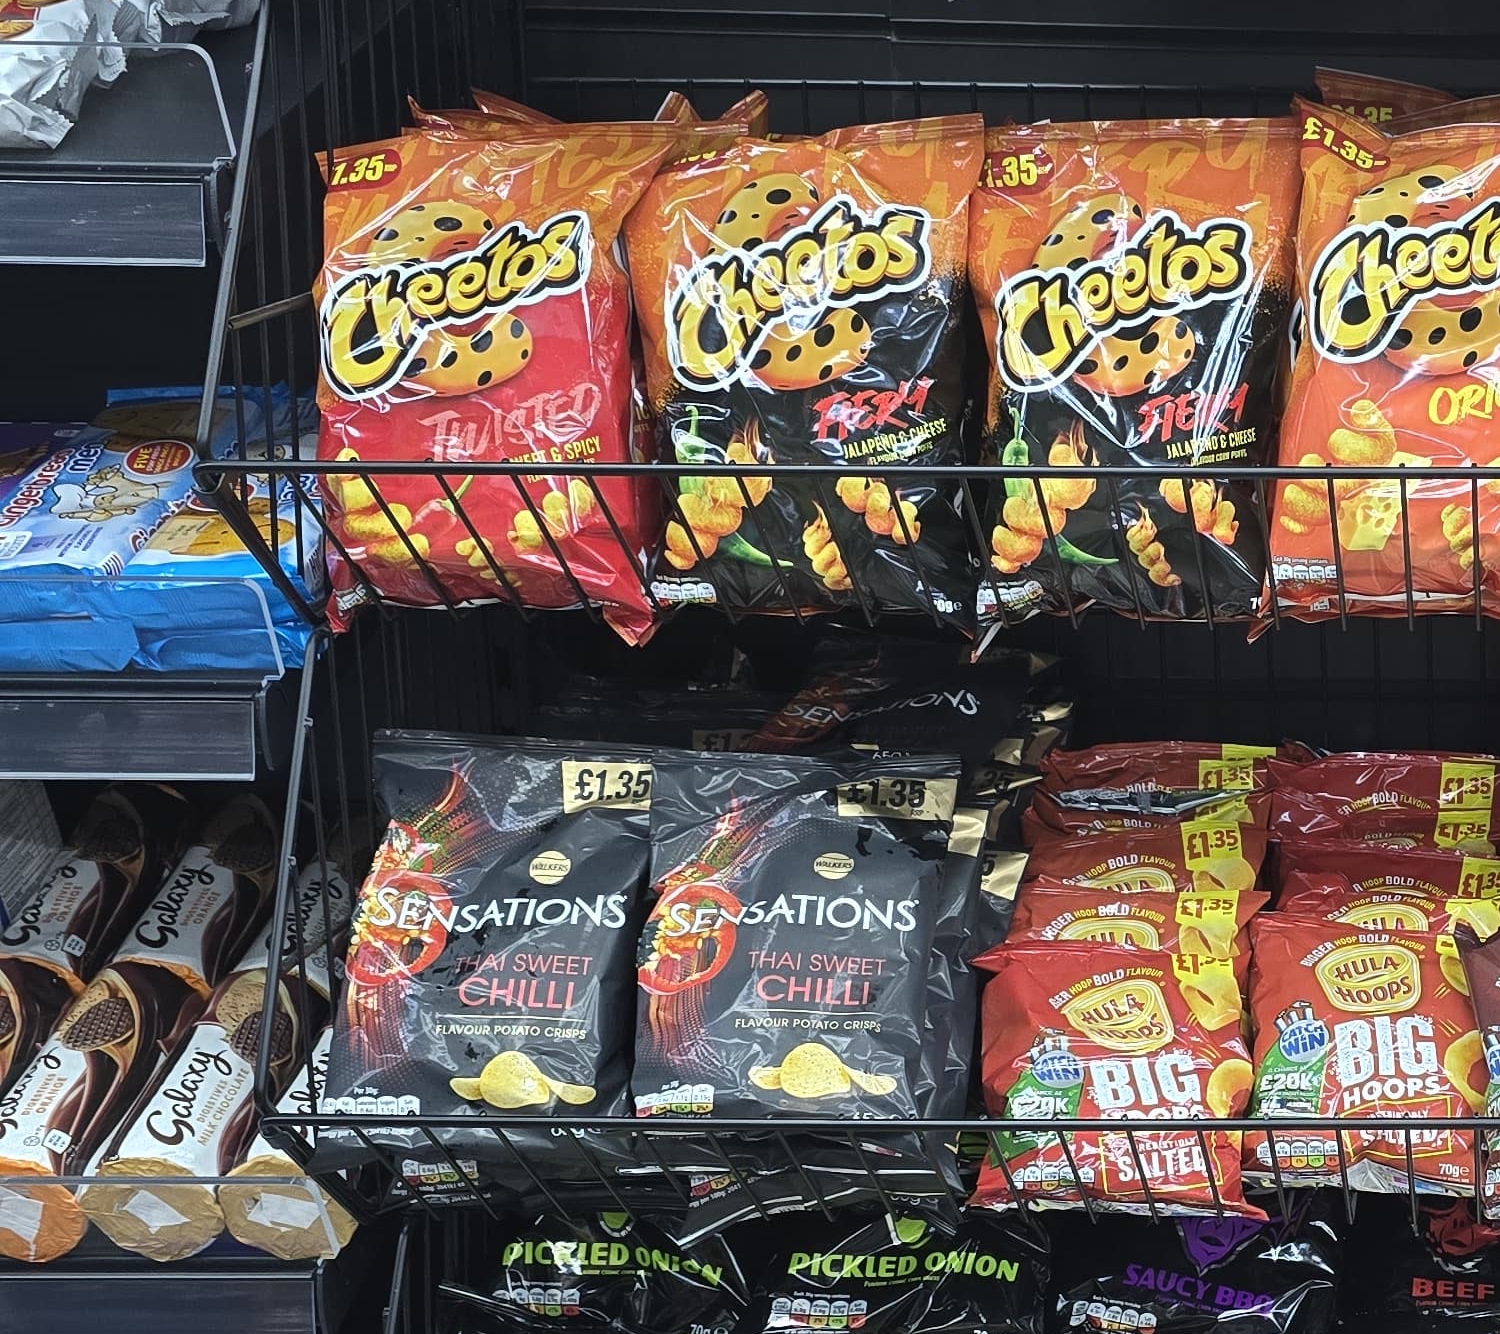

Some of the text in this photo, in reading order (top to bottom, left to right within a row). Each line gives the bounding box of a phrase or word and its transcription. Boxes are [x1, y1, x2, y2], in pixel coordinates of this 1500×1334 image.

[328, 216, 580, 388] Cheetos
[1005, 226, 1248, 387] Cheetos
[908, 418, 947, 444] CHEESE
[573, 769, 651, 802] £1.35
[530, 861, 568, 874] WALKERS
[369, 888, 628, 935] SENSATIONS
[664, 894, 921, 938] SENSATIONS
[513, 953, 593, 976] SWEET
[748, 951, 885, 976] THAI SWEET
[1300, 933, 1426, 968] BIGGER HOOP BOLD FLAVOUR
[1333, 956, 1400, 982] HULA
[457, 975, 575, 1010] CHILLI
[755, 975, 870, 1006] CHILLI
[1335, 976, 1412, 1005] HOOPS
[435, 1020, 587, 1041] FLAVOUR POTATO CRISPS
[1281, 1026, 1324, 1044] CATCH
[1332, 1015, 1439, 1087] BIG
[1259, 1070, 1314, 1092] £20K
[146, 1047, 234, 1147] Galaxy
[198, 1067, 252, 1146] MILK CHOCOLATE
[1439, 1162, 1460, 1177] 70g
[1123, 1264, 1208, 1299] SAUCY
[1411, 1277, 1495, 1300] BEEF
